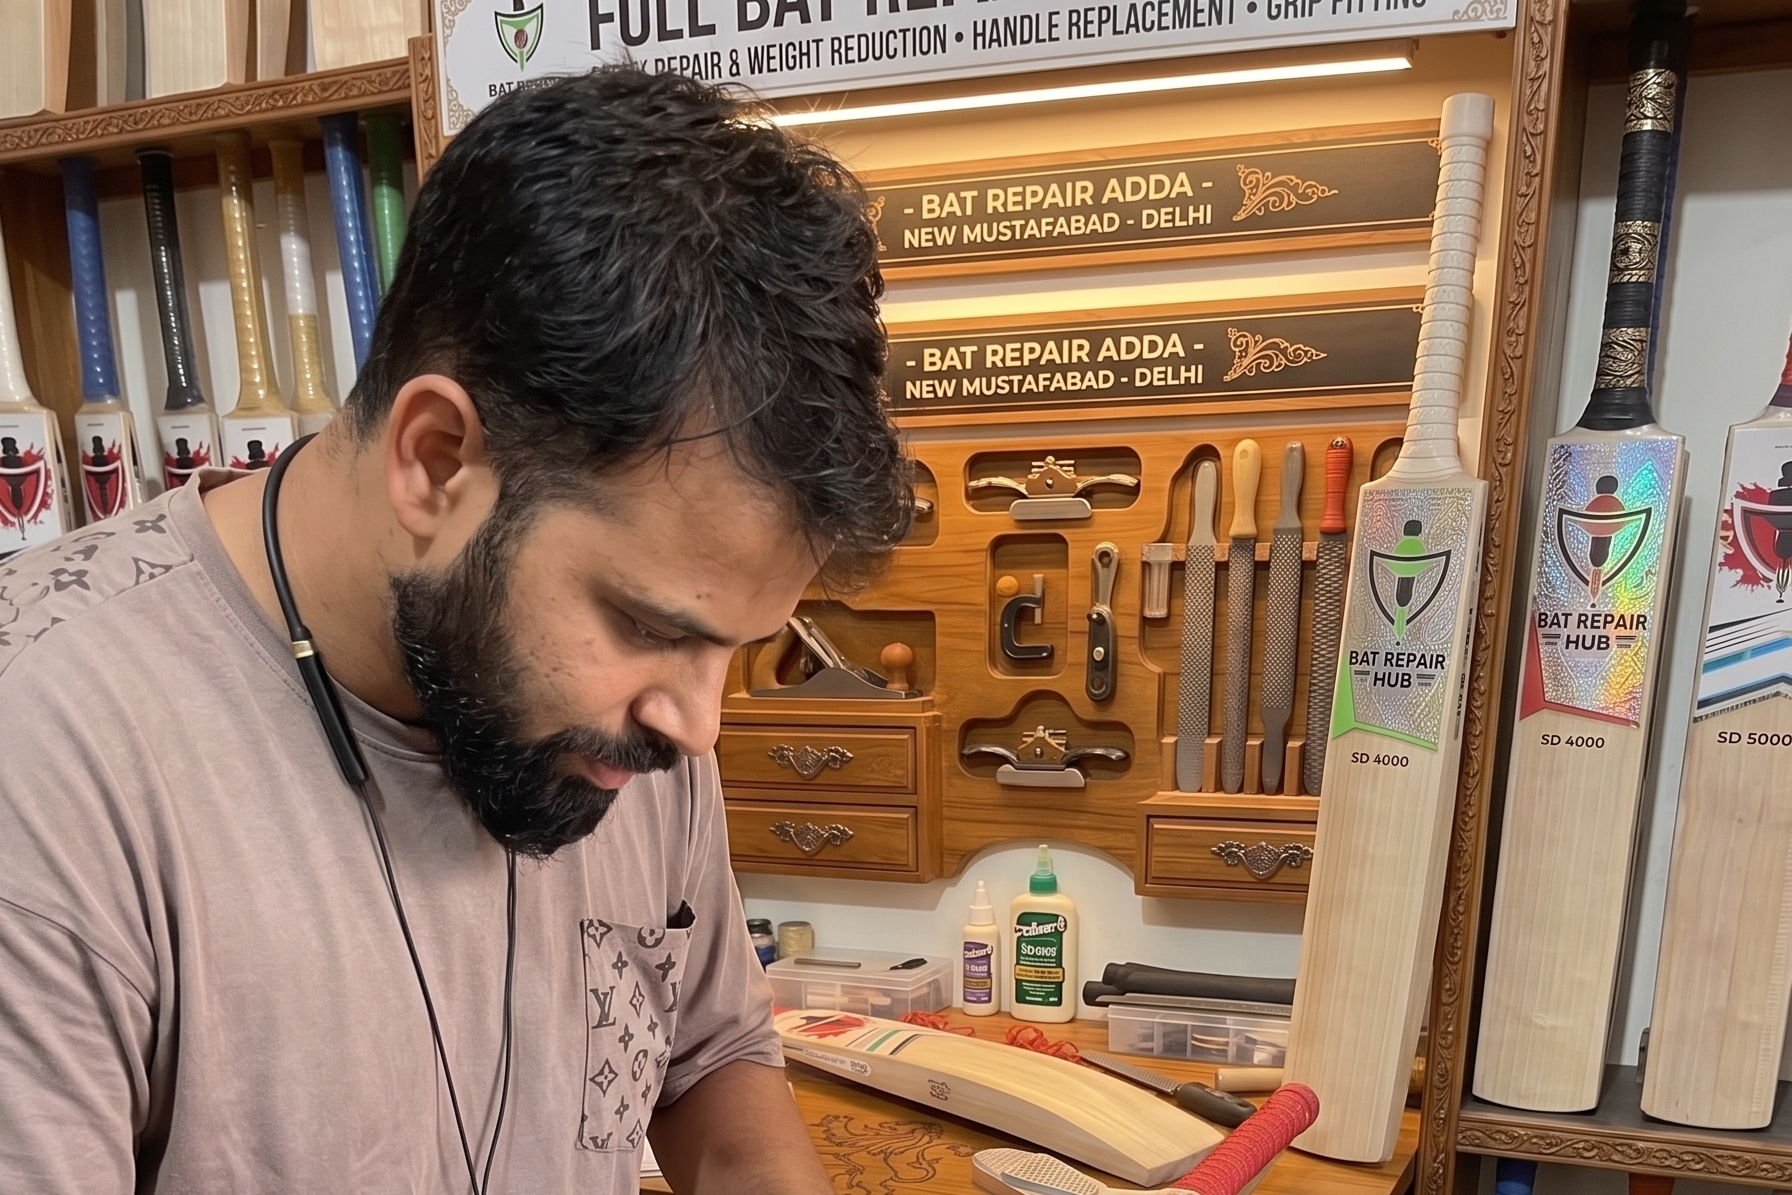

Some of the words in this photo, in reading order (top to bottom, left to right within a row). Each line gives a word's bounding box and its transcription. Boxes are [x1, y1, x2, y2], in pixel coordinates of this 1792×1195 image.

[589, 0, 716, 51] FULL
[729, 48, 741, 77] &
[747, 38, 823, 75] WEIGHT
[831, 24, 947, 66] REDUCTION
[973, 11, 1060, 50] HANDLE
[1067, 0, 1235, 40] REPLACEMENT
[488, 82, 514, 97] BAT
[921, 190, 978, 220] BAT
[987, 180, 1094, 214] REPAIR
[1101, 171, 1193, 205] ADDA
[903, 226, 957, 249] NEW
[962, 213, 1120, 245] MUSTAFABAD
[1141, 204, 1212, 230] DELHI
[922, 345, 978, 372] BAT
[985, 337, 1090, 368] REPAIR
[1097, 332, 1185, 362] ADDA
[905, 378, 957, 399] NEW
[962, 370, 1114, 396] MUSTAFABAD
[1135, 364, 1204, 387] DELHI
[1537, 612, 1574, 629] BAT
[1577, 613, 1648, 631] REPAIR
[1565, 634, 1610, 651] HUB
[1349, 650, 1379, 667] BAT
[1383, 652, 1446, 671] REPAIR
[1373, 671, 1413, 690] HUB
[1540, 733, 1562, 747] SD
[1564, 734, 1605, 750] 4000
[1717, 731, 1742, 744] SD
[1746, 732, 1792, 747] 5000
[1351, 751, 1371, 766] SD
[1373, 754, 1410, 768] 4000
